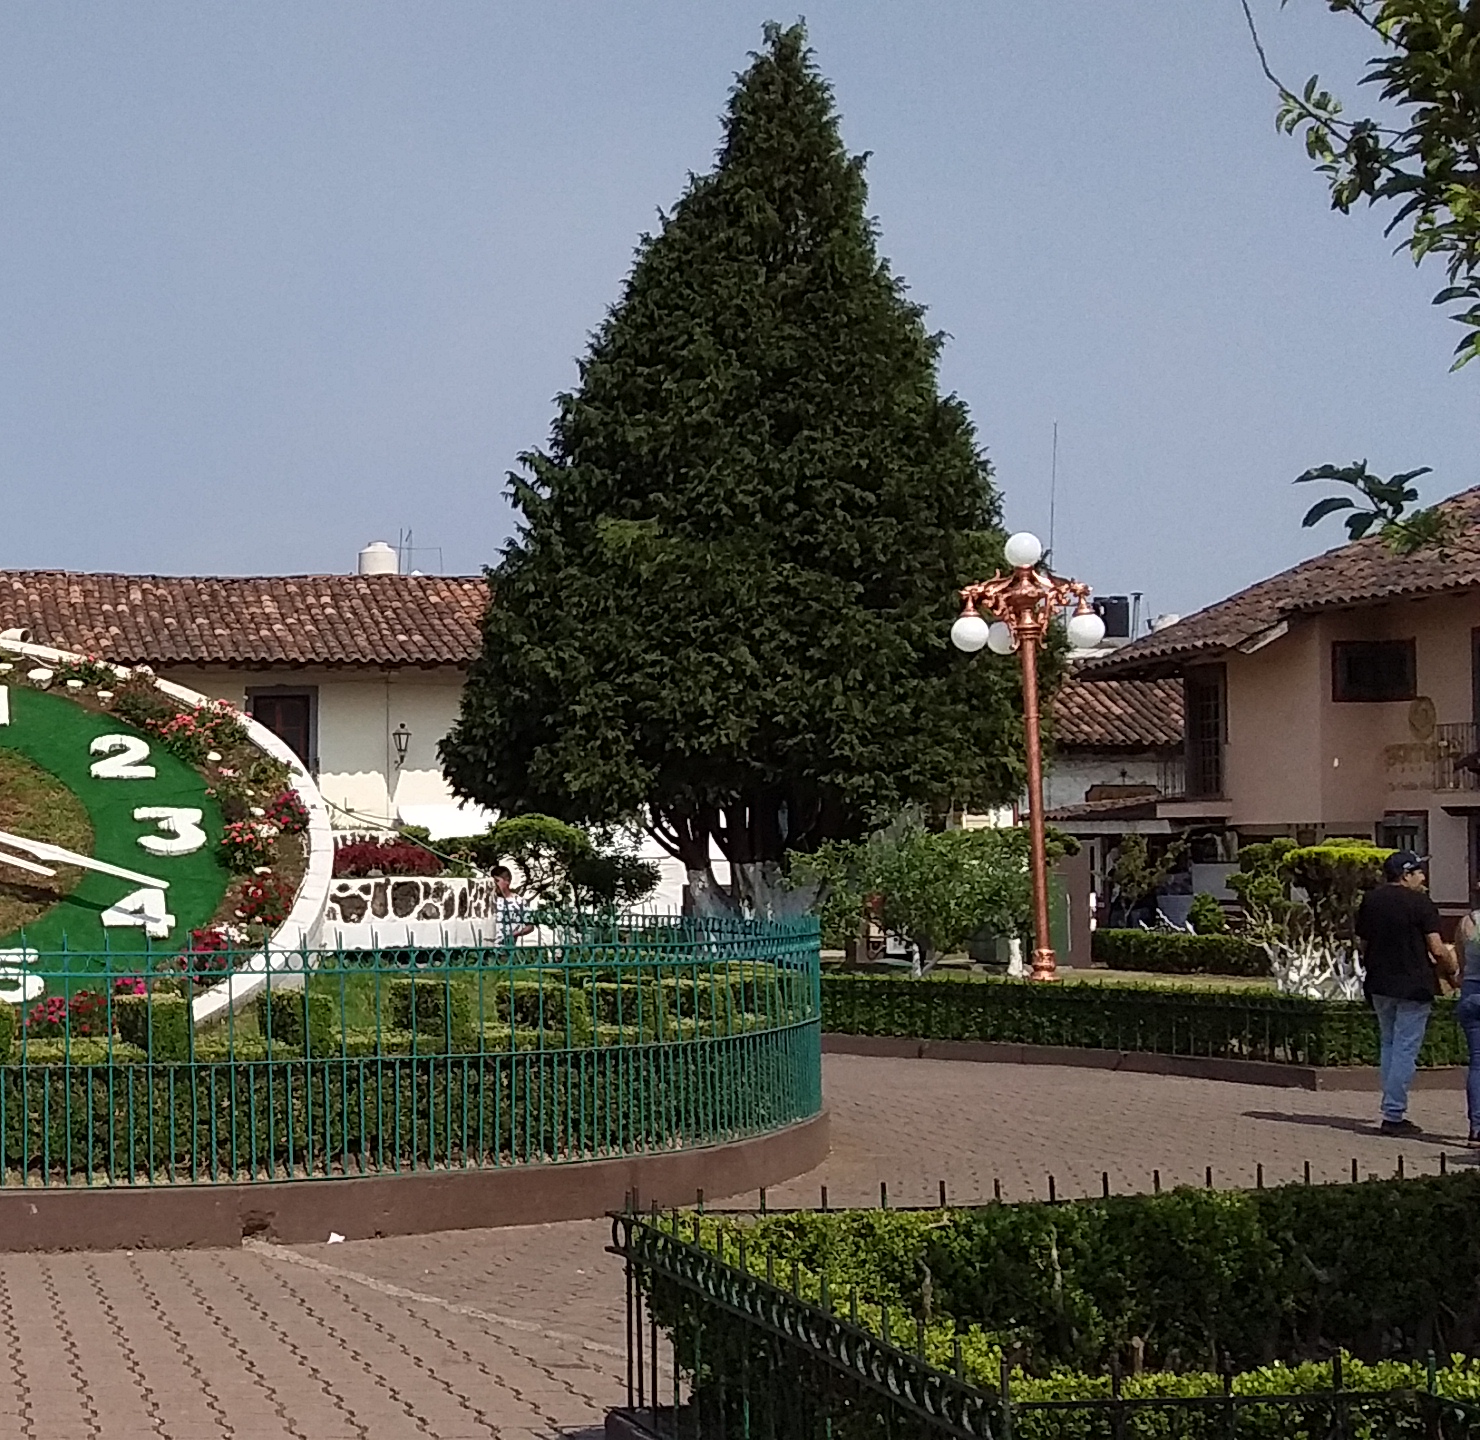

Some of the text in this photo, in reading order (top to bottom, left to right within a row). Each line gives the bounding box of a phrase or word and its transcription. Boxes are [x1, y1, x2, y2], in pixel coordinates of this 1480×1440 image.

[90, 733, 156, 779] 2
[133, 806, 207, 856] 3
[100, 888, 176, 938] 4
